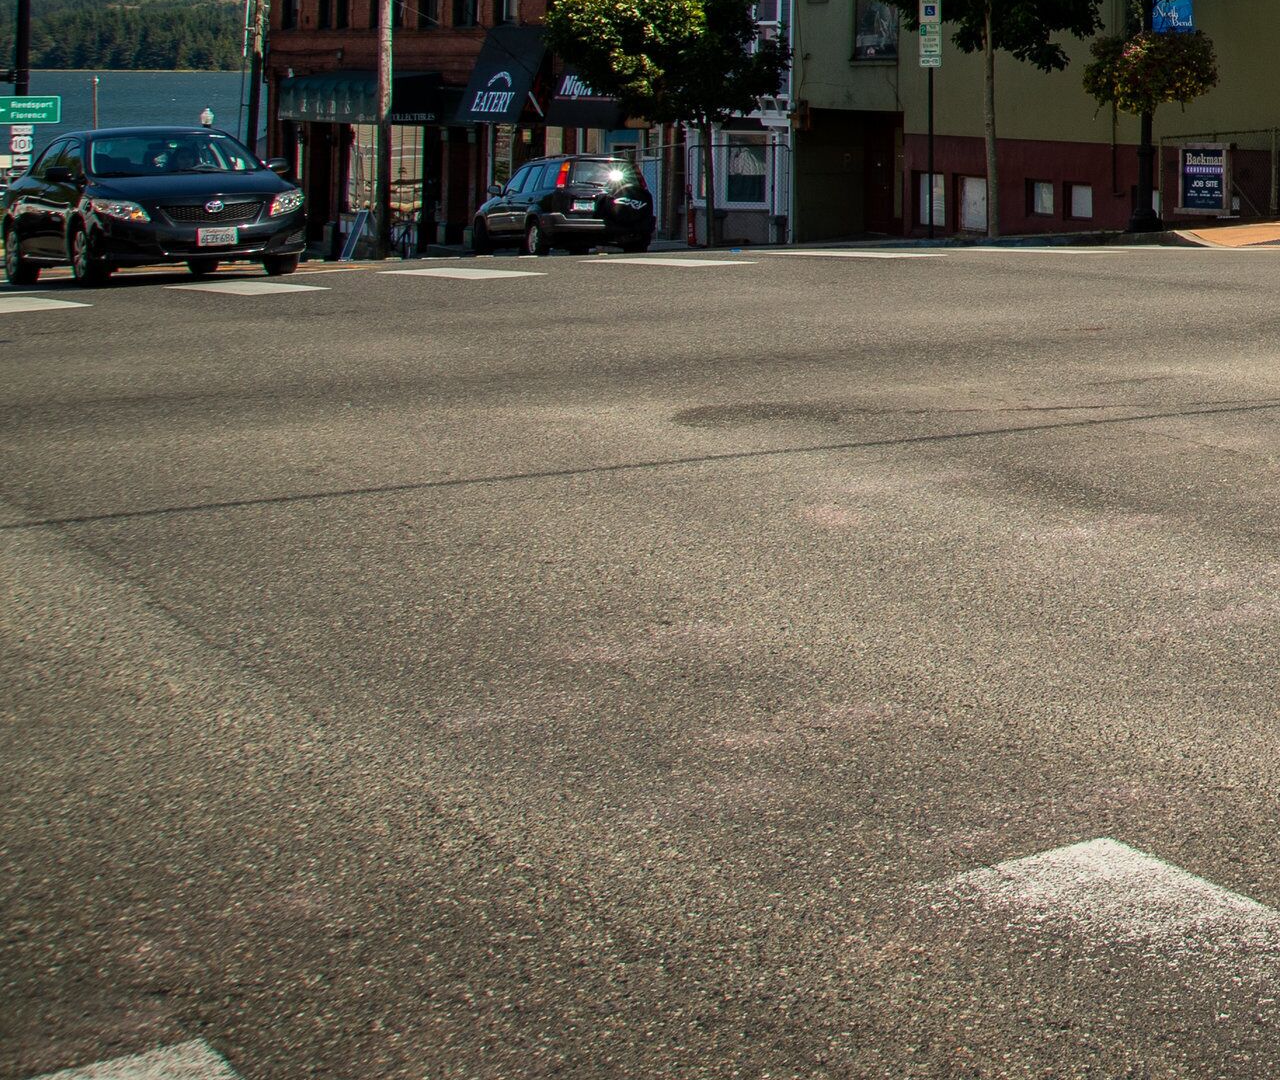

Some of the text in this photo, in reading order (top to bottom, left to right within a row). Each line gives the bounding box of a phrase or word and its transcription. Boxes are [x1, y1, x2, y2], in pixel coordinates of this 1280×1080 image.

[1172, 15, 1193, 27] Bend
[10, 101, 54, 110] Reedsport
[470, 91, 515, 113] EATERY
[10, 111, 48, 119] Florence
[13, 139, 32, 149] 101
[1186, 153, 1223, 165] Backman
